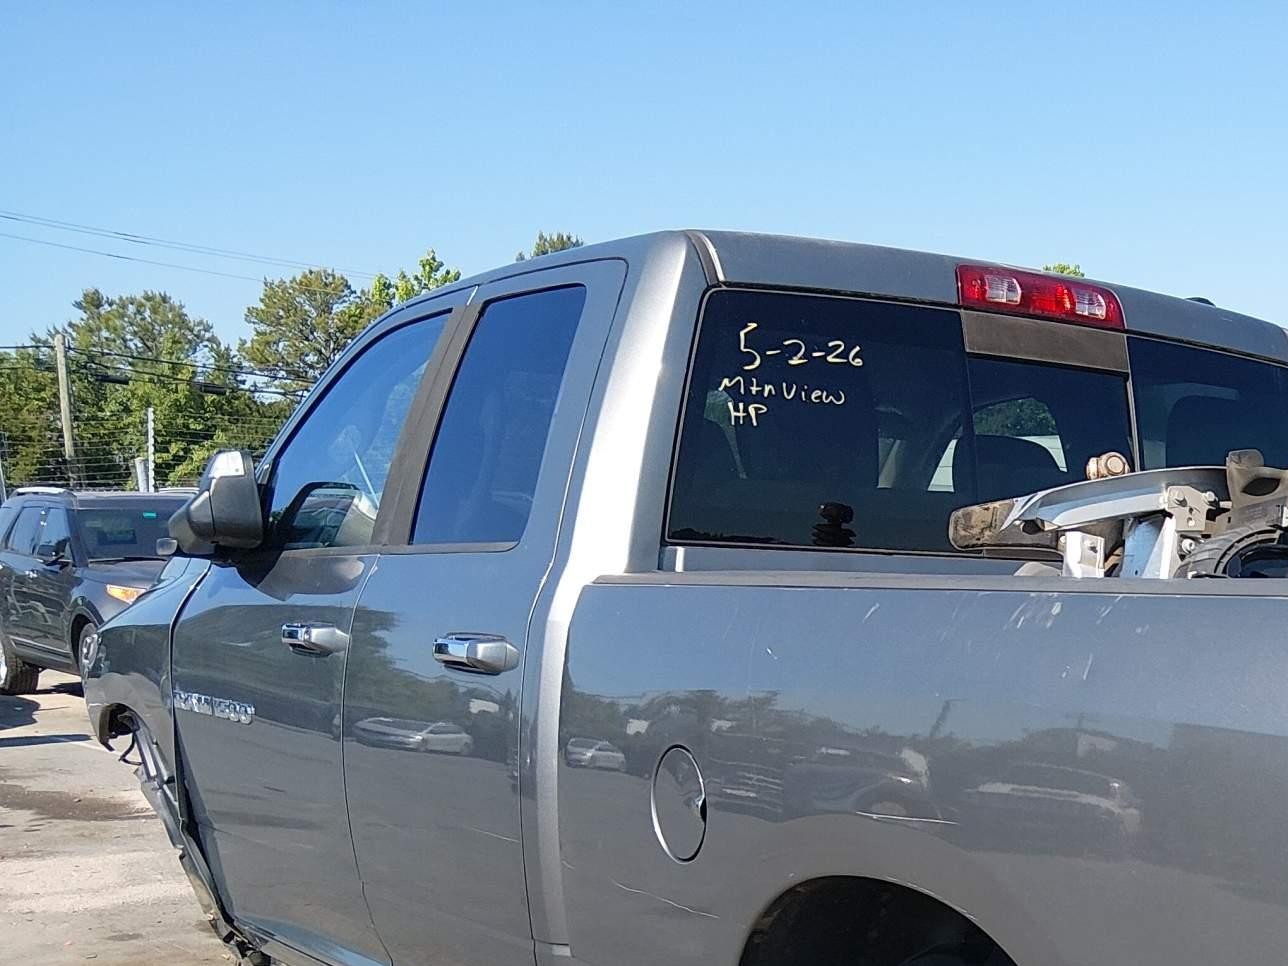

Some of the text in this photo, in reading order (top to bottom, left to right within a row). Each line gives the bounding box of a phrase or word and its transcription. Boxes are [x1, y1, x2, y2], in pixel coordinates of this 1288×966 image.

[740, 322, 864, 371] 5-2-26
[718, 375, 776, 396] Mtn
[727, 401, 768, 427] HP
